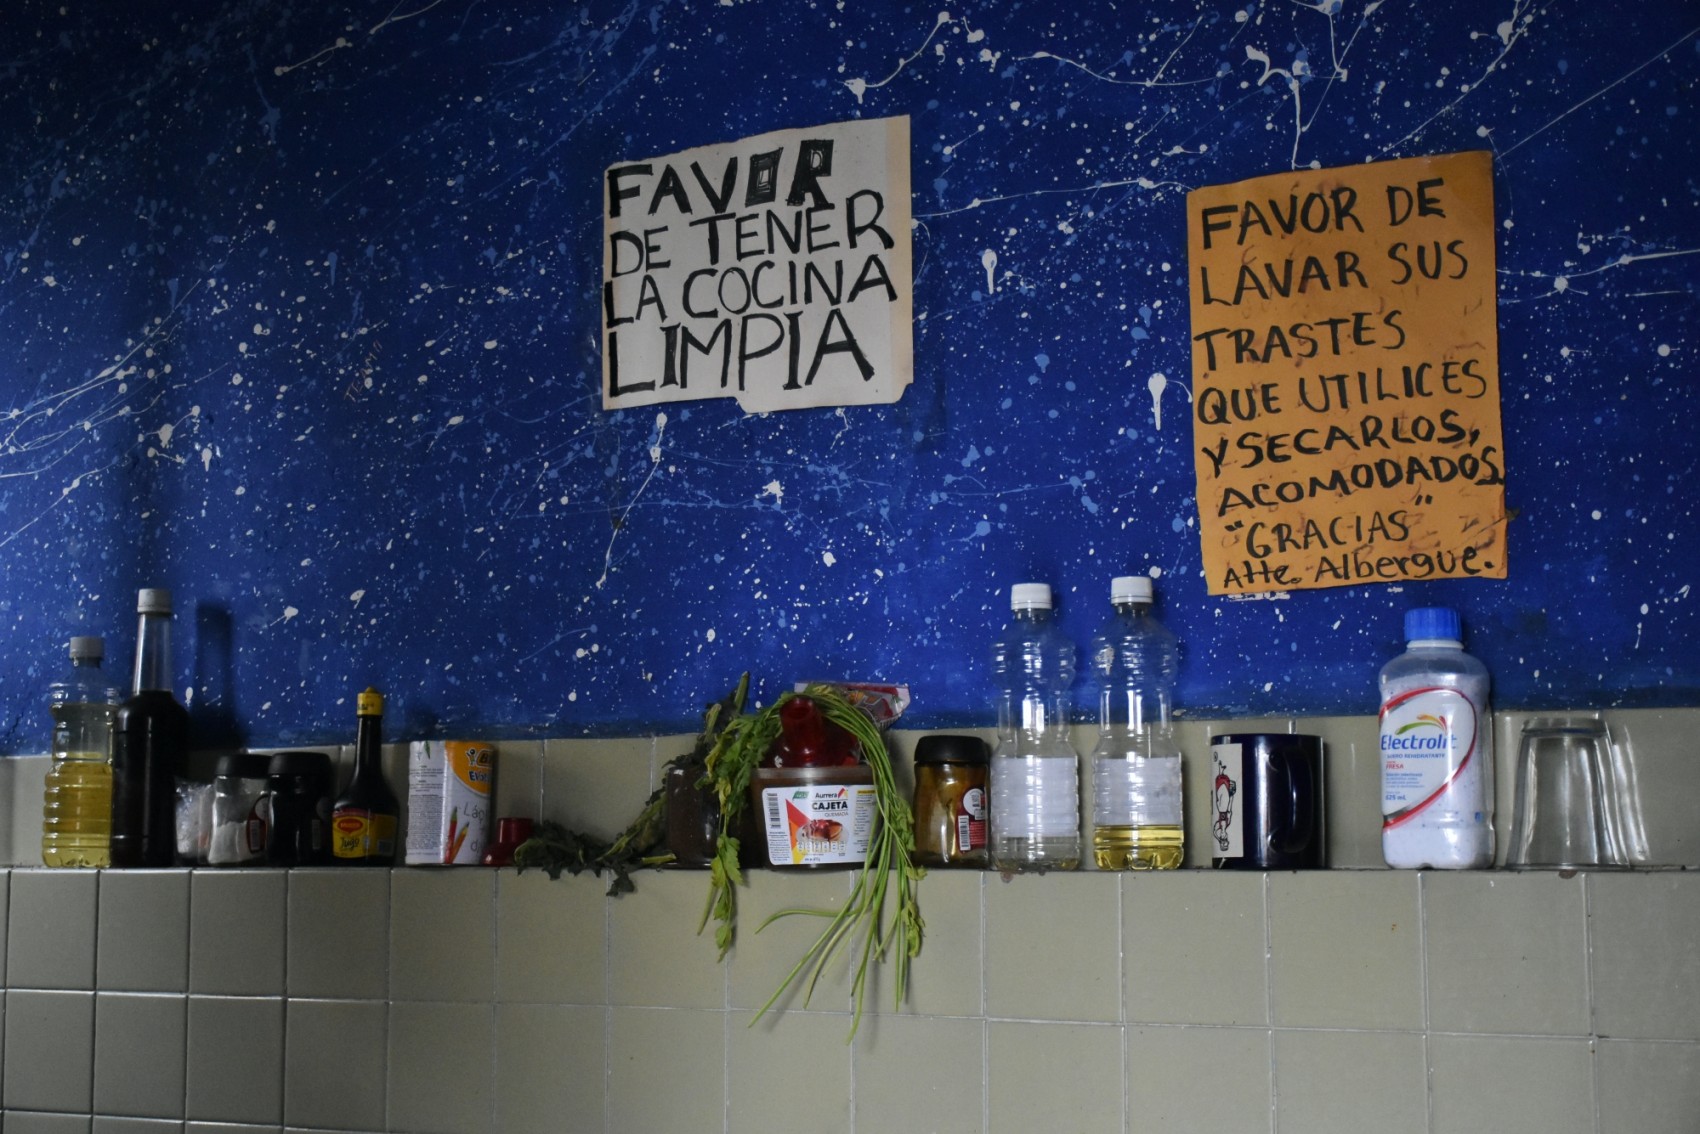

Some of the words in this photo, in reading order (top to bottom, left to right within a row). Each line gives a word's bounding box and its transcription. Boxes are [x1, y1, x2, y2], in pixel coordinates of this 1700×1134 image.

[608, 139, 835, 218] FAVOR
[1201, 186, 1364, 249] FAVOR
[1387, 178, 1446, 226] DE
[610, 225, 671, 278] DE
[689, 189, 895, 265] TENER
[604, 275, 667, 328] LA
[682, 254, 898, 318] COCINA
[1200, 251, 1368, 306] LAVAR
[1388, 240, 1468, 285] SUS
[608, 308, 875, 397] LIMPIA
[1193, 309, 1406, 371] TRASTES
[1197, 383, 1282, 424] QUE
[1299, 359, 1487, 413] UTILICES
[811, 801, 848, 810] CAJETA
